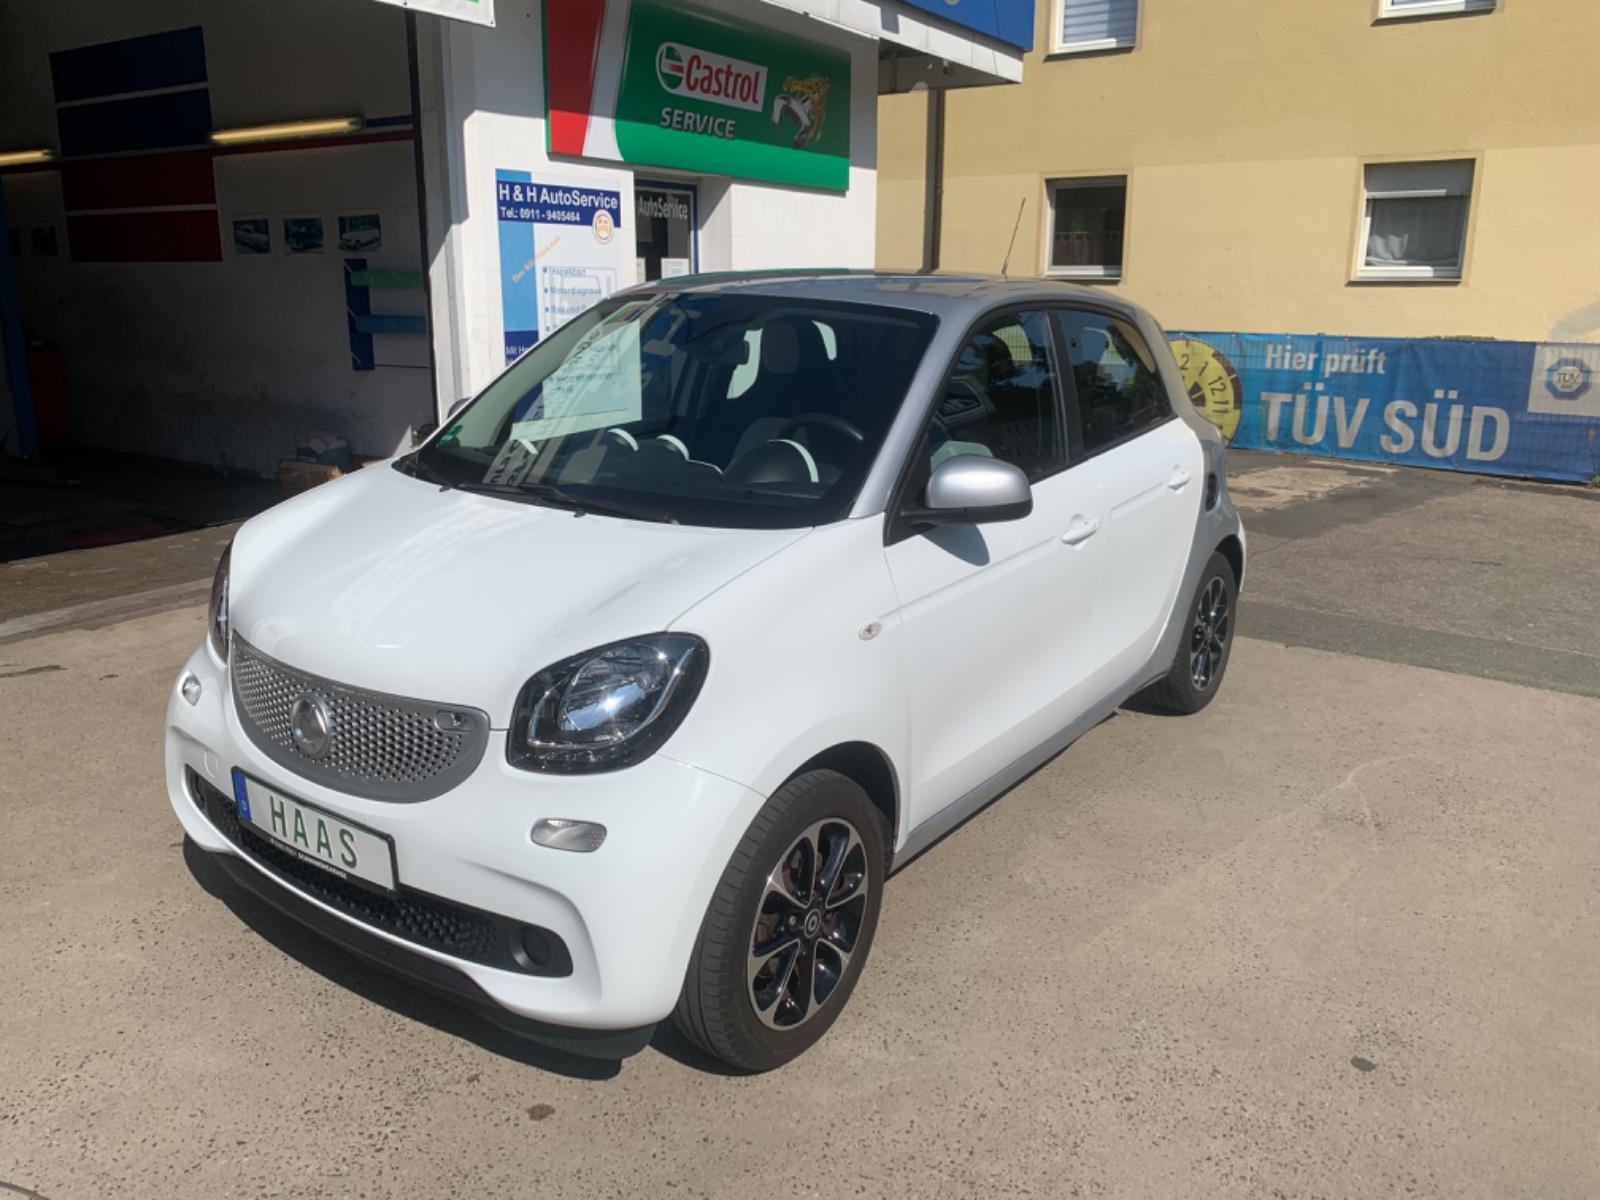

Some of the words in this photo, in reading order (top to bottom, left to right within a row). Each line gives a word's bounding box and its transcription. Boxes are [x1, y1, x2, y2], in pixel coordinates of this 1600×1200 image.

[685, 54, 760, 105] Castrol
[660, 107, 736, 138] SERVICE
[499, 183, 510, 201] H
[513, 185, 524, 202] &
[526, 186, 537, 203] H
[540, 187, 618, 209] AutoService
[638, 195, 689, 219] AutoService
[1179, 353, 1190, 370] 2
[1198, 360, 1209, 376] 1
[1265, 343, 1319, 370] Hier
[1324, 348, 1387, 378] prüft
[1208, 375, 1226, 396] 12
[1212, 399, 1229, 414] 11
[1260, 382, 1371, 449] TÜV
[1380, 389, 1510, 461] SÜD
[270, 796, 358, 869] HAAS
